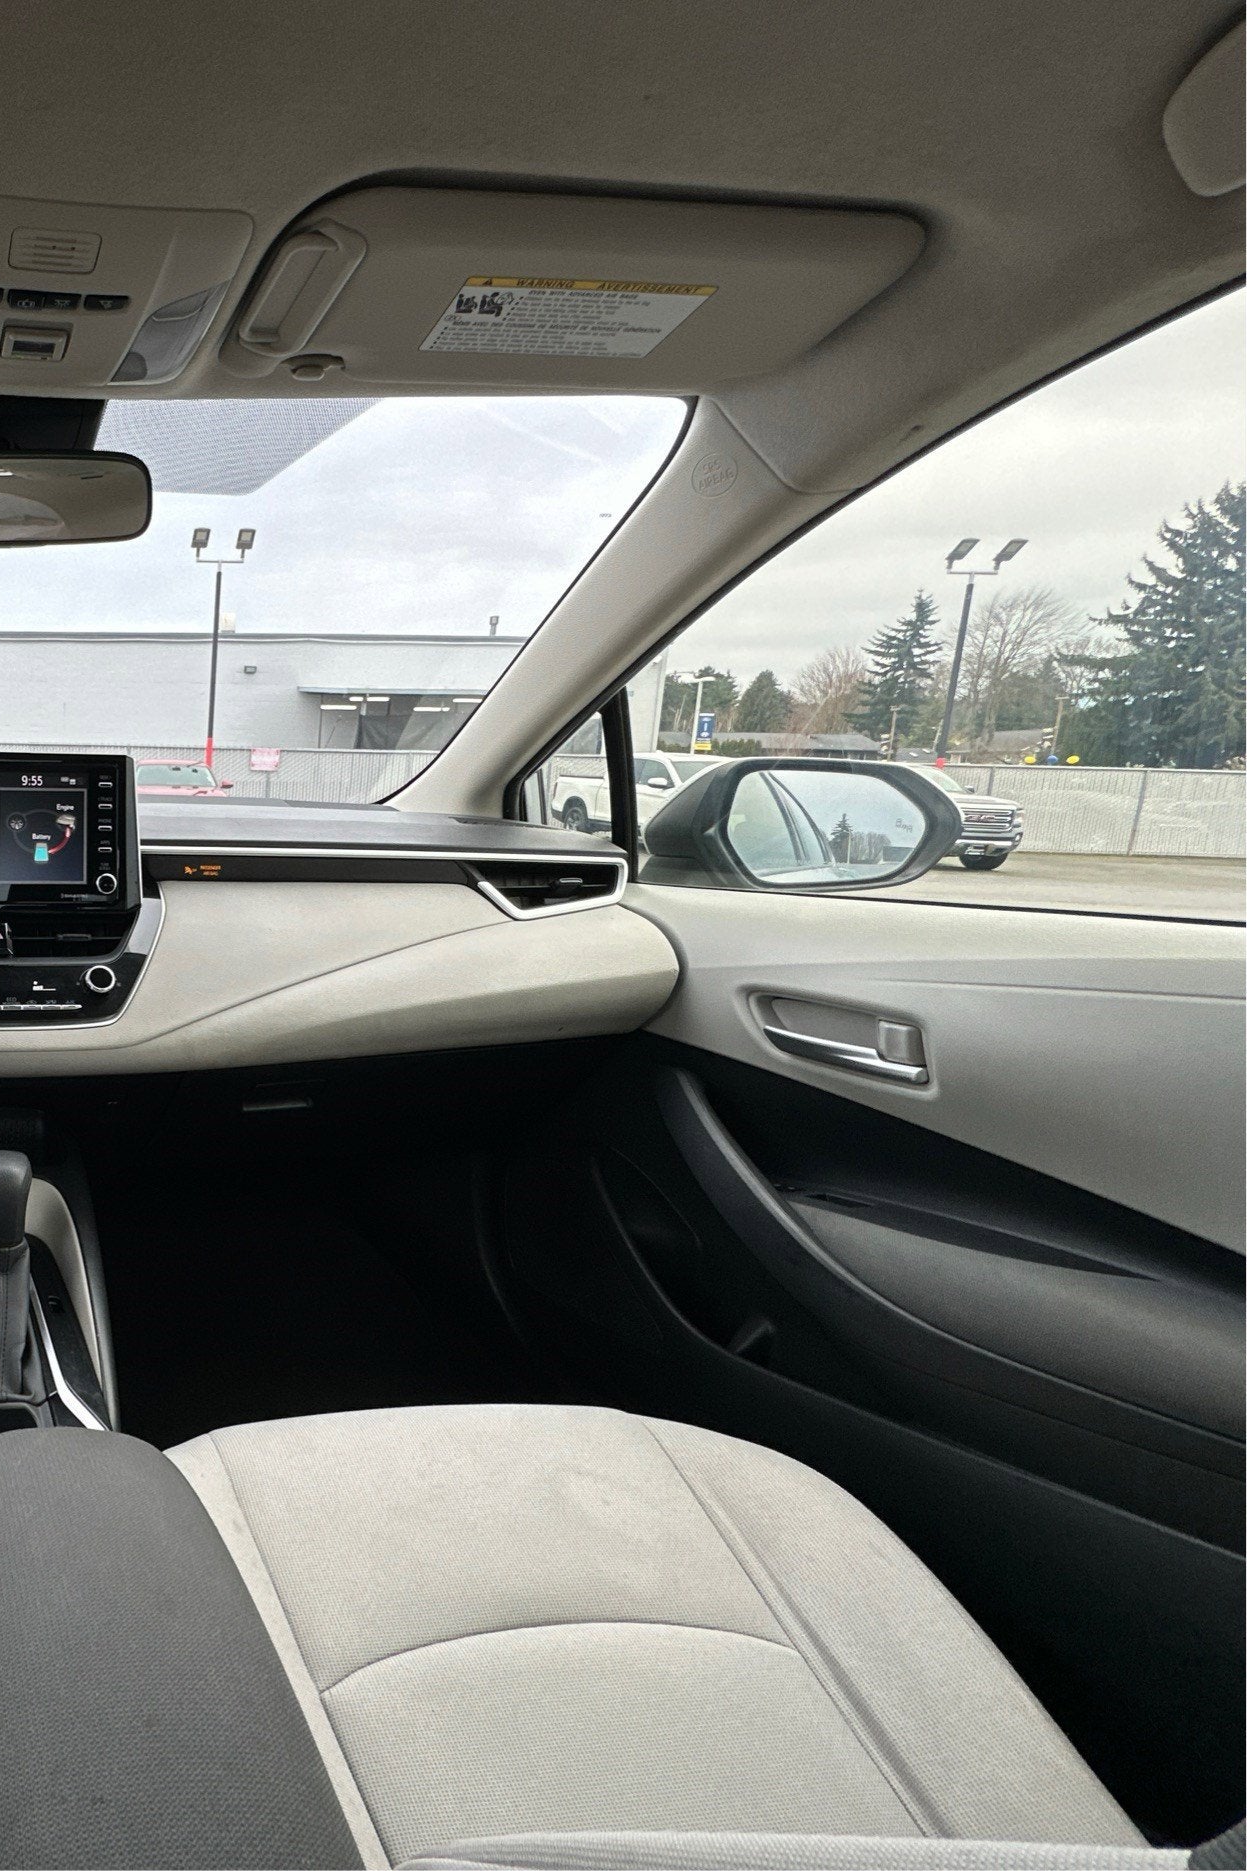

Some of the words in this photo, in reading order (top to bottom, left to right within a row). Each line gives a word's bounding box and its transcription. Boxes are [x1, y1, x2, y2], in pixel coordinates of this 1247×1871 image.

[516, 279, 575, 289] WARNING
[597, 281, 699, 295] AVERTISSEMENT
[698, 467, 735, 491] AIRBAG
[21, 775, 43, 787] 9:55
[56, 803, 74, 812] Engine
[32, 833, 51, 842] Battery
